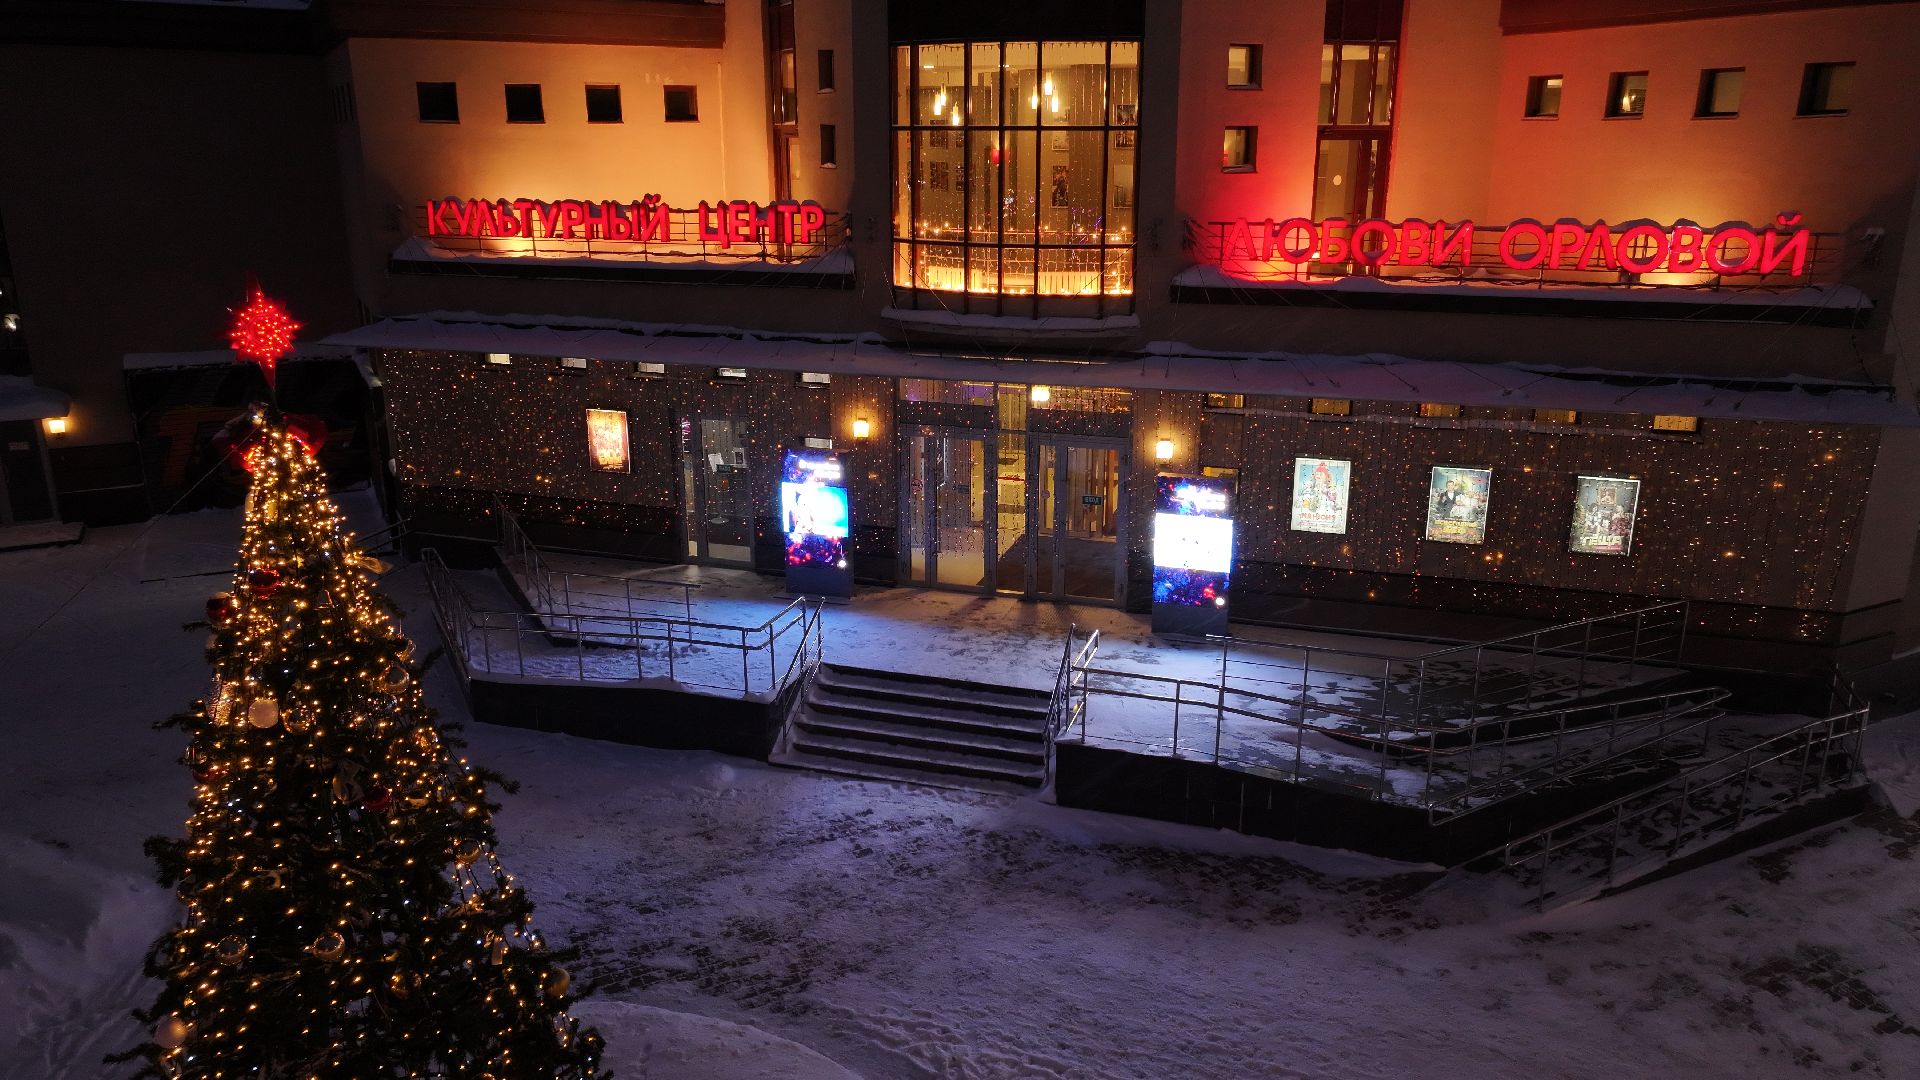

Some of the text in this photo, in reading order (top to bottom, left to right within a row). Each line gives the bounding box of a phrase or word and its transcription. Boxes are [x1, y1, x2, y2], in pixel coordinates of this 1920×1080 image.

[427, 194, 827, 248] КУЛЬТУРНЫЙ ЦЕНТР
[1223, 214, 1811, 277] ЛЮБОВИ ОРЛОВОЙ
